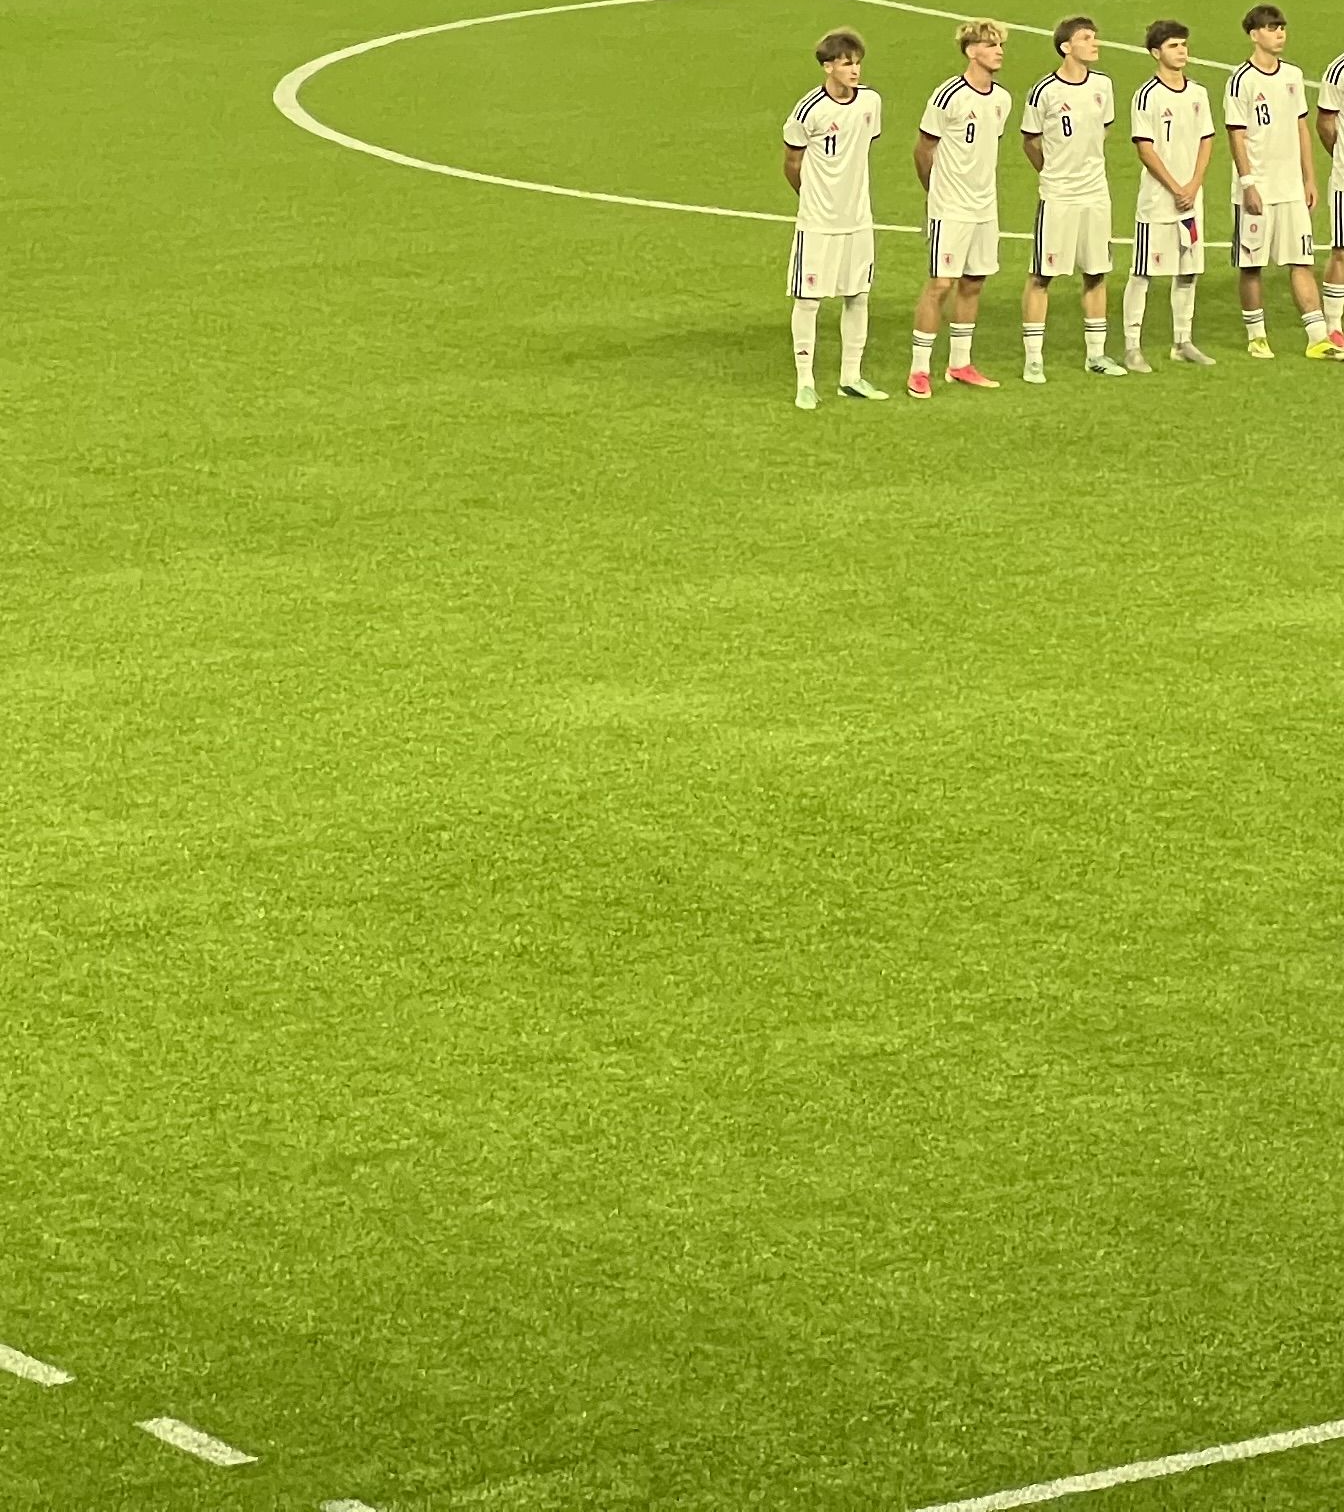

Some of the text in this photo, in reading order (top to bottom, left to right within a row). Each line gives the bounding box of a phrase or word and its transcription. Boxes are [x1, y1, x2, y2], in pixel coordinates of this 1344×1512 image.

[1255, 103, 1271, 126] 13
[1061, 115, 1073, 137] 8
[1163, 120, 1171, 142] 7
[824, 134, 837, 156] 11
